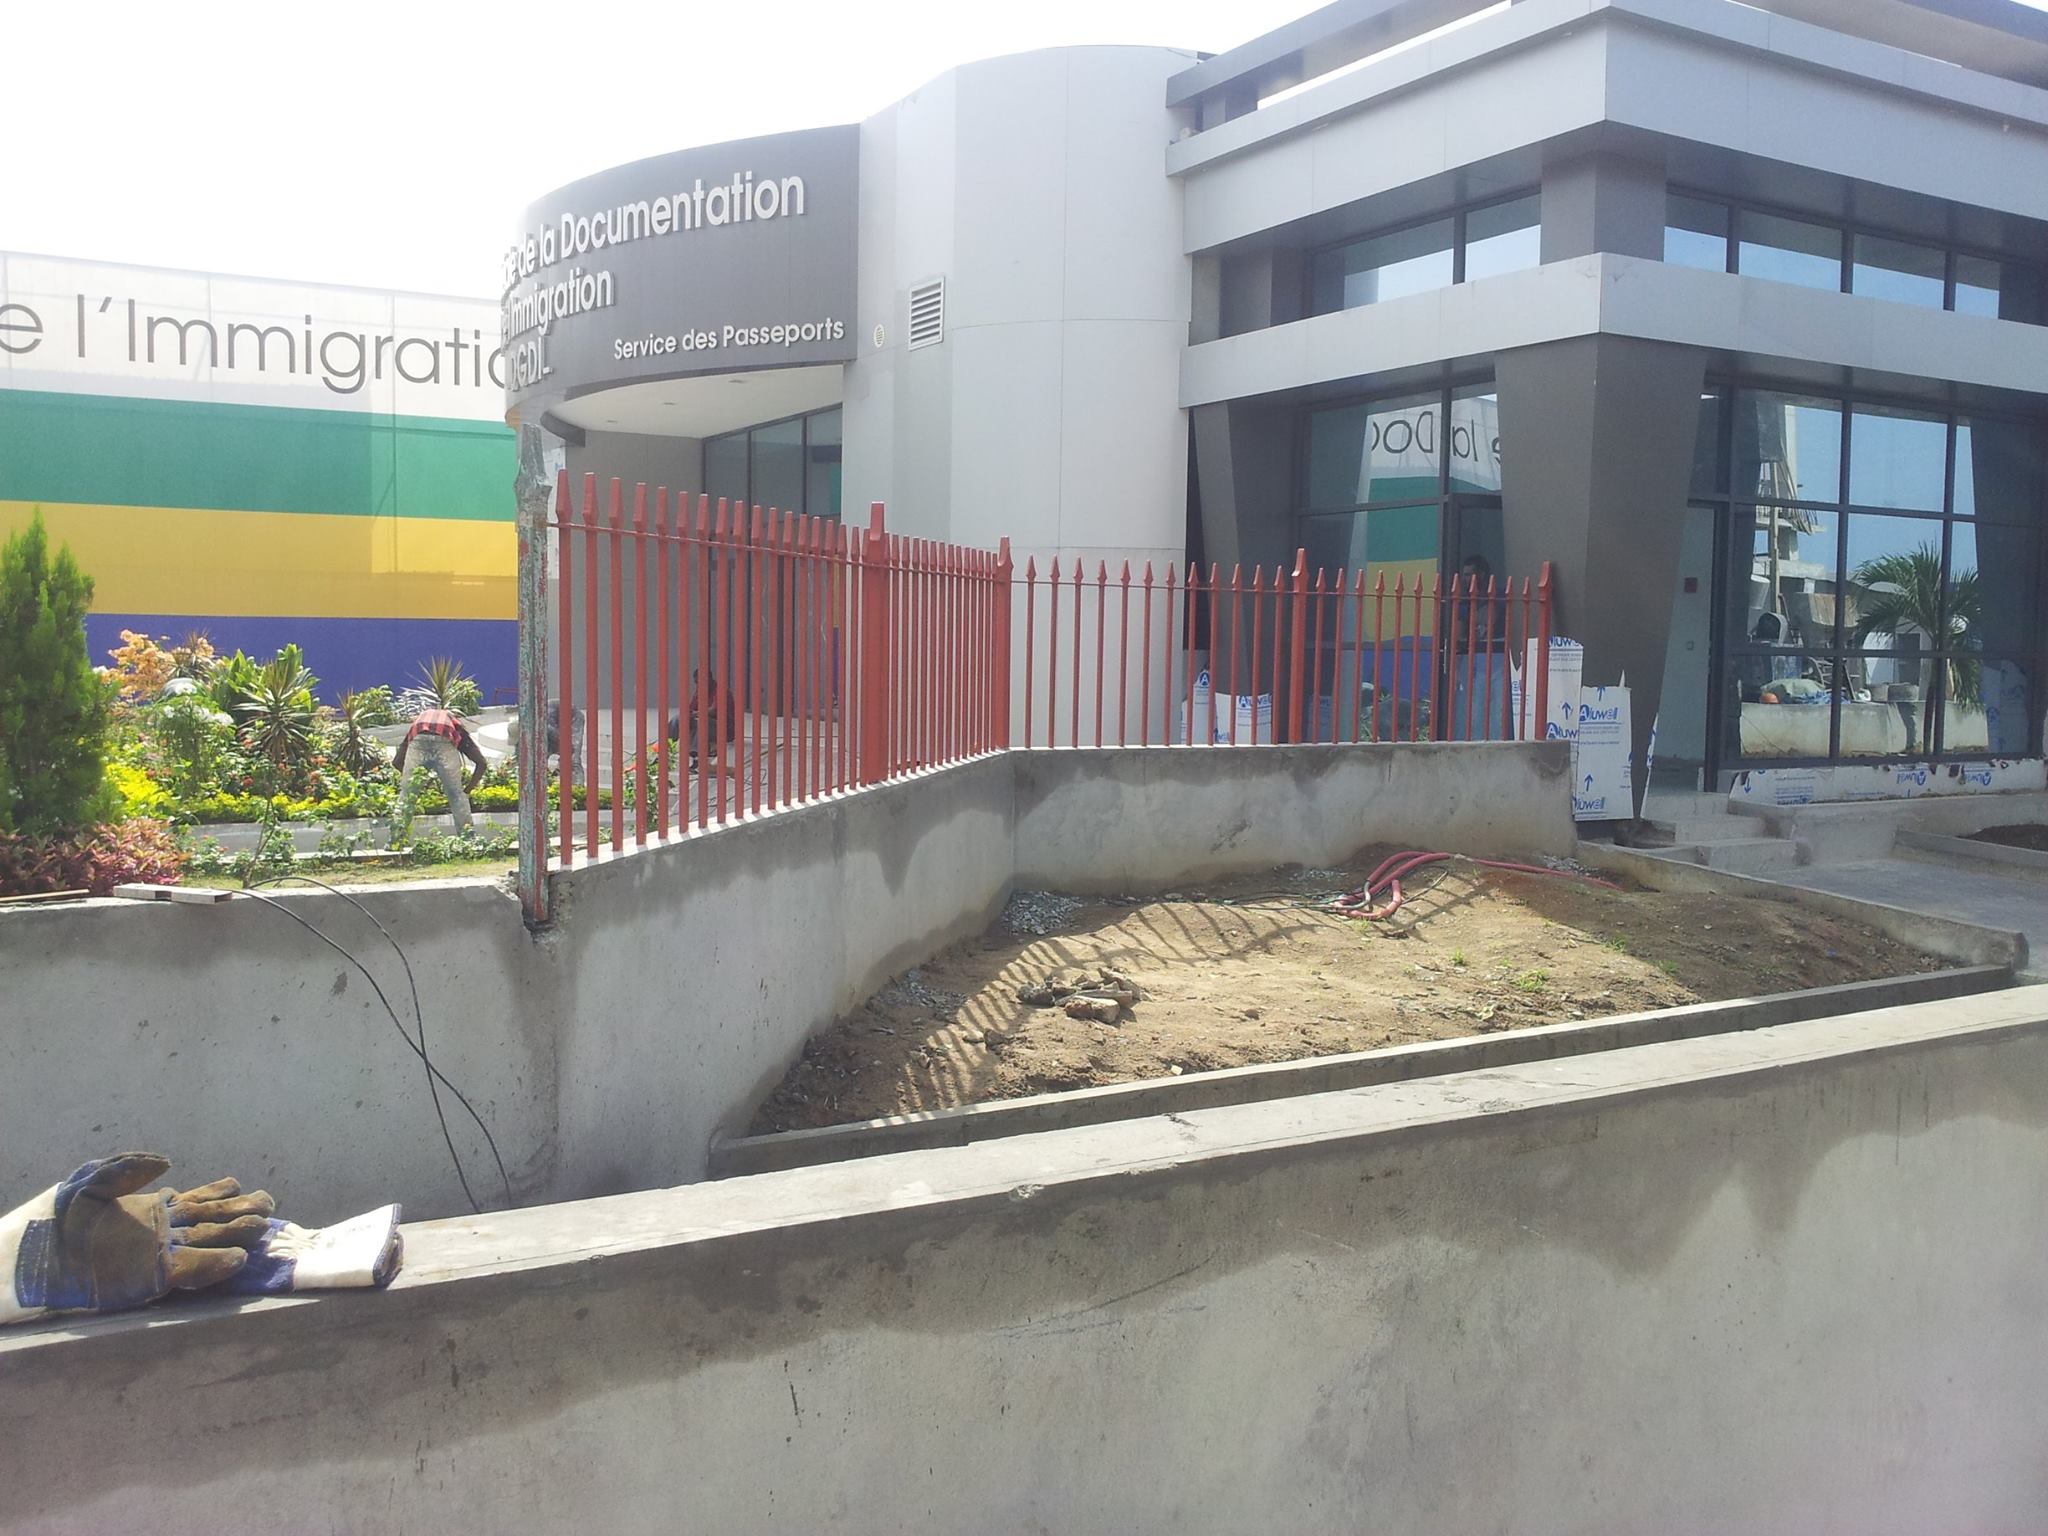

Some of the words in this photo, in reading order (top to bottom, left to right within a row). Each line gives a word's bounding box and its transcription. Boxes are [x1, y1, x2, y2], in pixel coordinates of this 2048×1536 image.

[540, 223, 555, 268] la
[561, 170, 804, 258] Documentation
[614, 333, 677, 360] Service
[682, 329, 717, 351] des
[723, 317, 844, 347] Passeports
